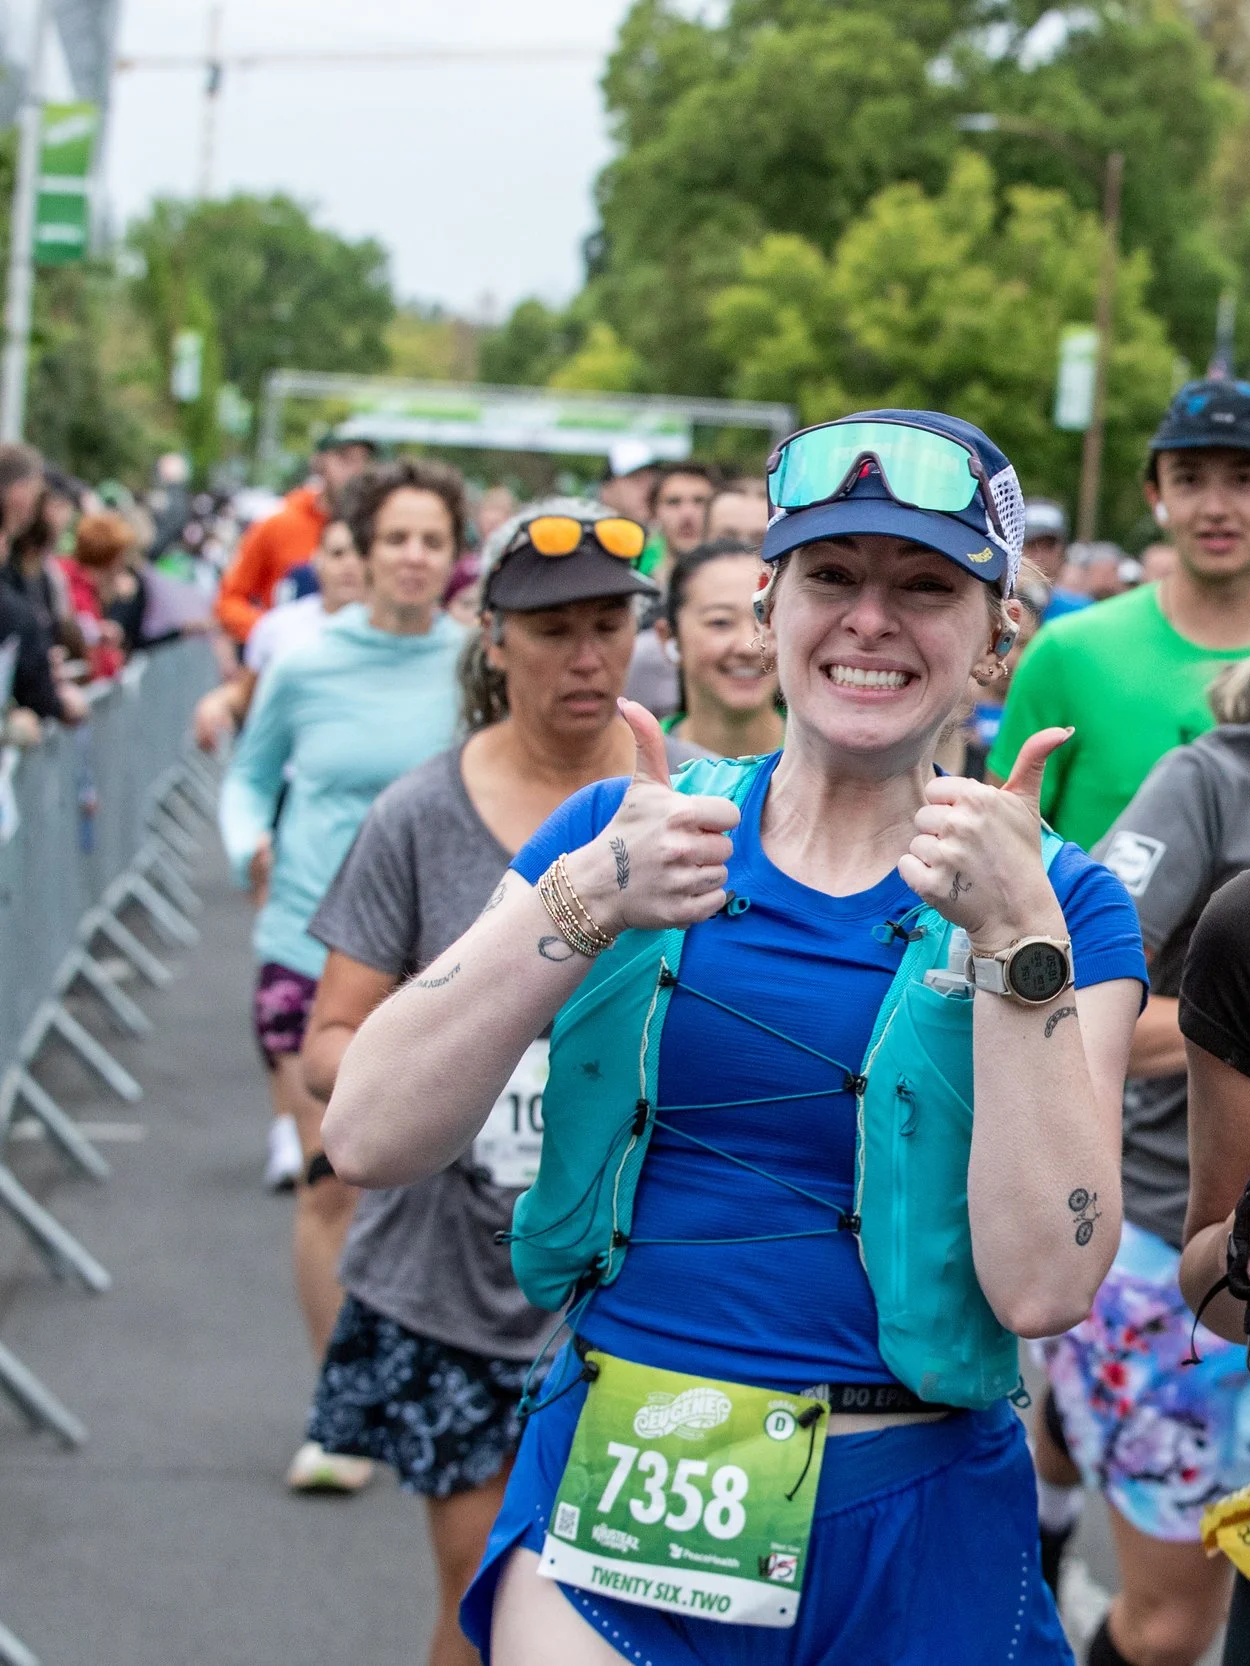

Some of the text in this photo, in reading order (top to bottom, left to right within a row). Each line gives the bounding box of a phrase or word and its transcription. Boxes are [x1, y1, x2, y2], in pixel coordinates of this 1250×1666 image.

[774, 1417, 786, 1432] D
[597, 1441, 749, 1540] 7358
[591, 1565, 653, 1597] TWENTY
